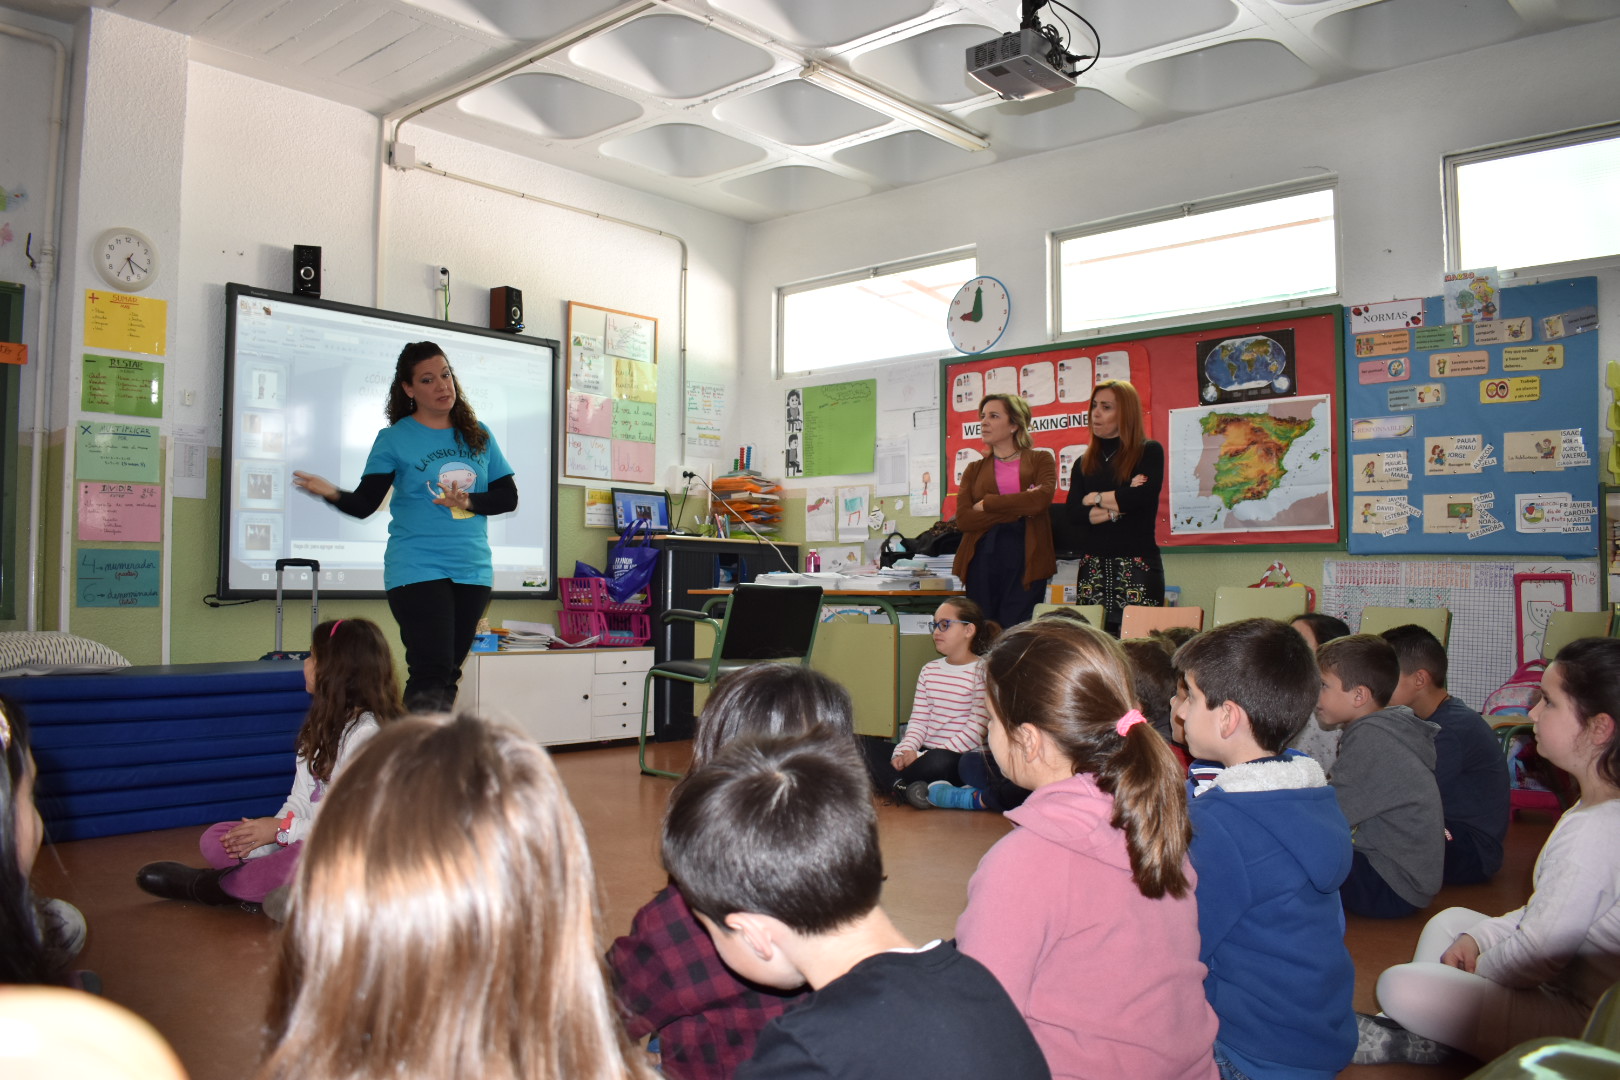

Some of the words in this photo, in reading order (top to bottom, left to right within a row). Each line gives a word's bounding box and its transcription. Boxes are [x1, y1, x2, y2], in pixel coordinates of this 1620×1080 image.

[1364, 311, 1408, 323] NORMAS
[964, 424, 980, 436] WE
[1028, 417, 1068, 431] AKING
[1068, 415, 1081, 427] IN
[414, 456, 431, 472] LA
[1473, 493, 1492, 502] PEDRO
[1384, 510, 1408, 520] ESTEBAN
[1564, 508, 1597, 516] CAROLINA
[1383, 525, 1408, 536] VICTORIA
[1469, 524, 1502, 538] ALEJANDRA
[82, 554, 95, 573] 4
[104, 559, 156, 573] numerador
[83, 583, 96, 602] 6
[107, 588, 158, 599] denominador
